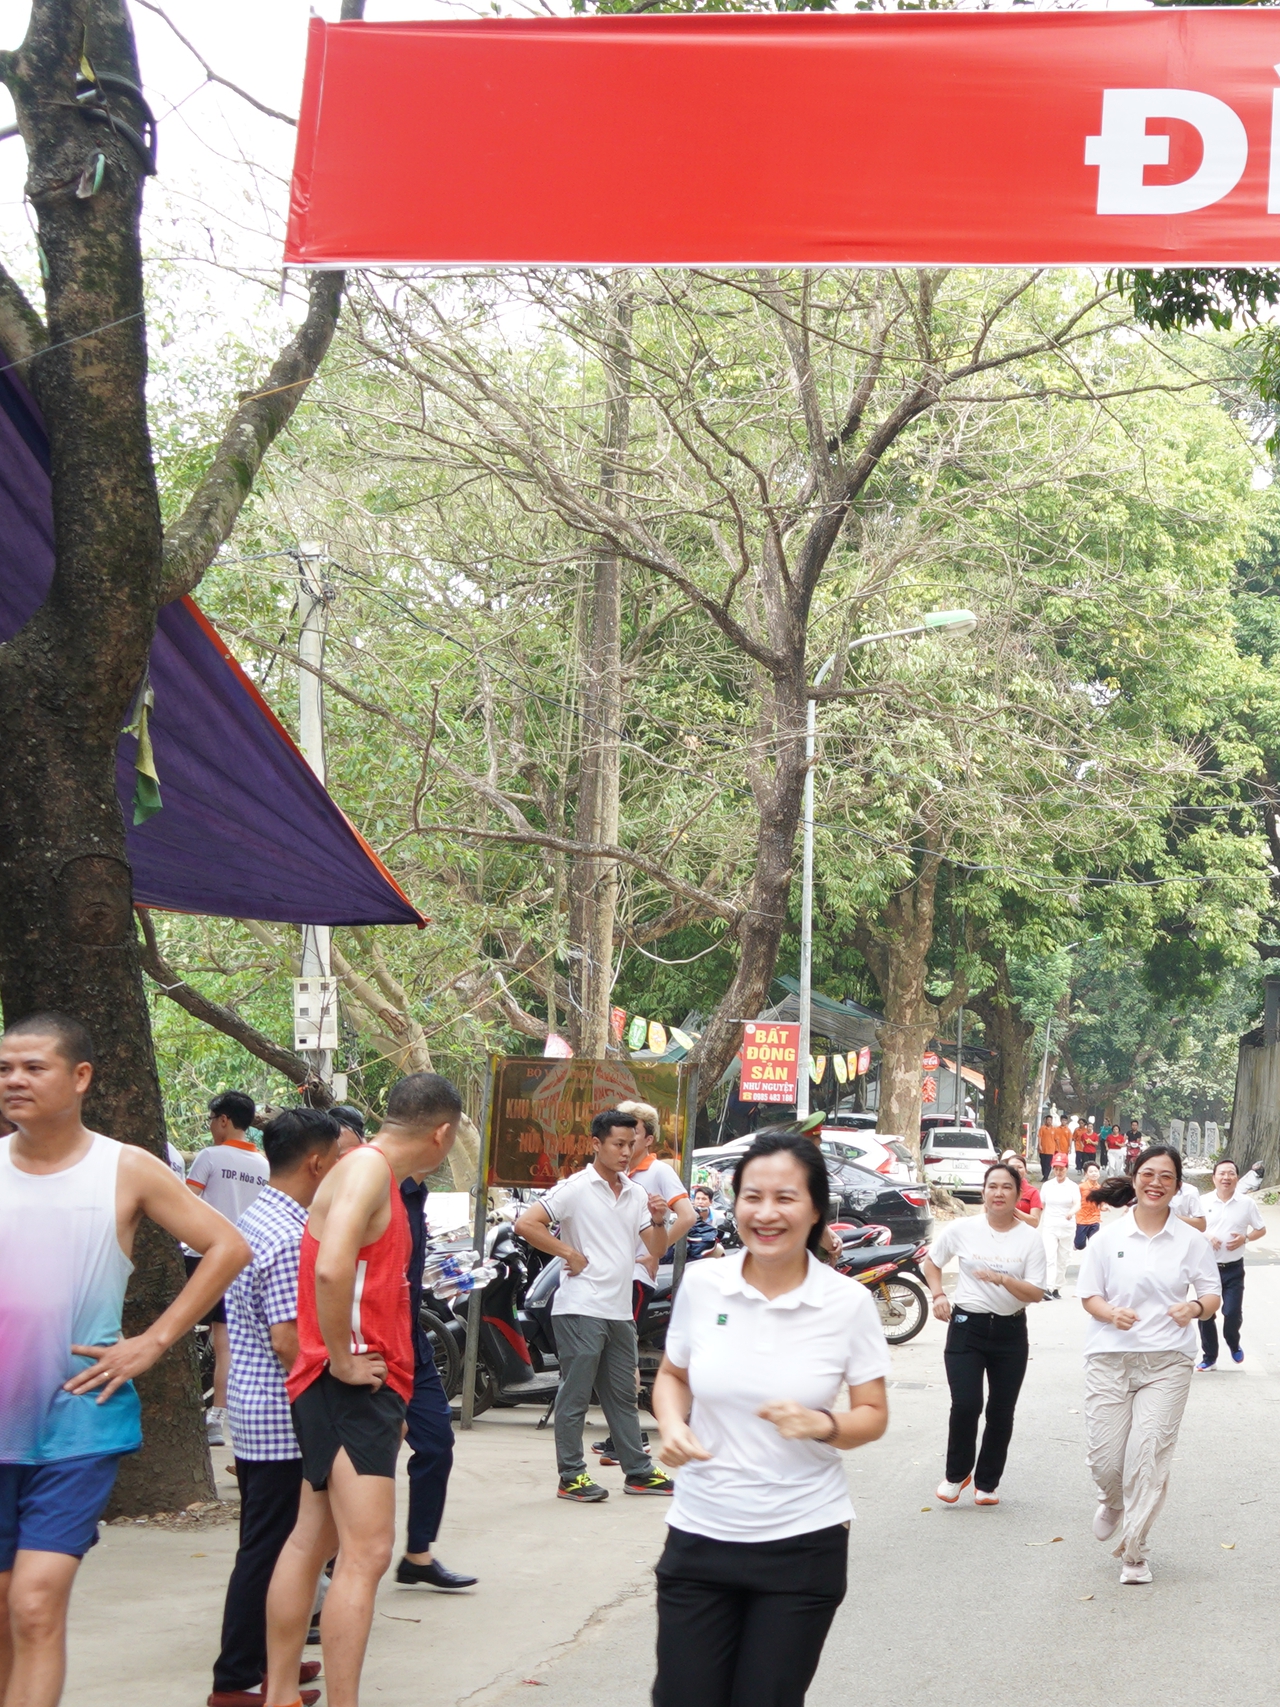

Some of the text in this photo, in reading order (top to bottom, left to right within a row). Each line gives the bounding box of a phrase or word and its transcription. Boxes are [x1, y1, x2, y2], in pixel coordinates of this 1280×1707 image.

[755, 1026, 789, 1044] BẤT
[746, 1044, 796, 1063] ĐỘNG
[751, 1062, 788, 1080] SẢN
[743, 1081, 795, 1093] NHƯ NGUYỆT
[221, 1168, 238, 1180] TDP.
[239, 1172, 255, 1184] Hòa
